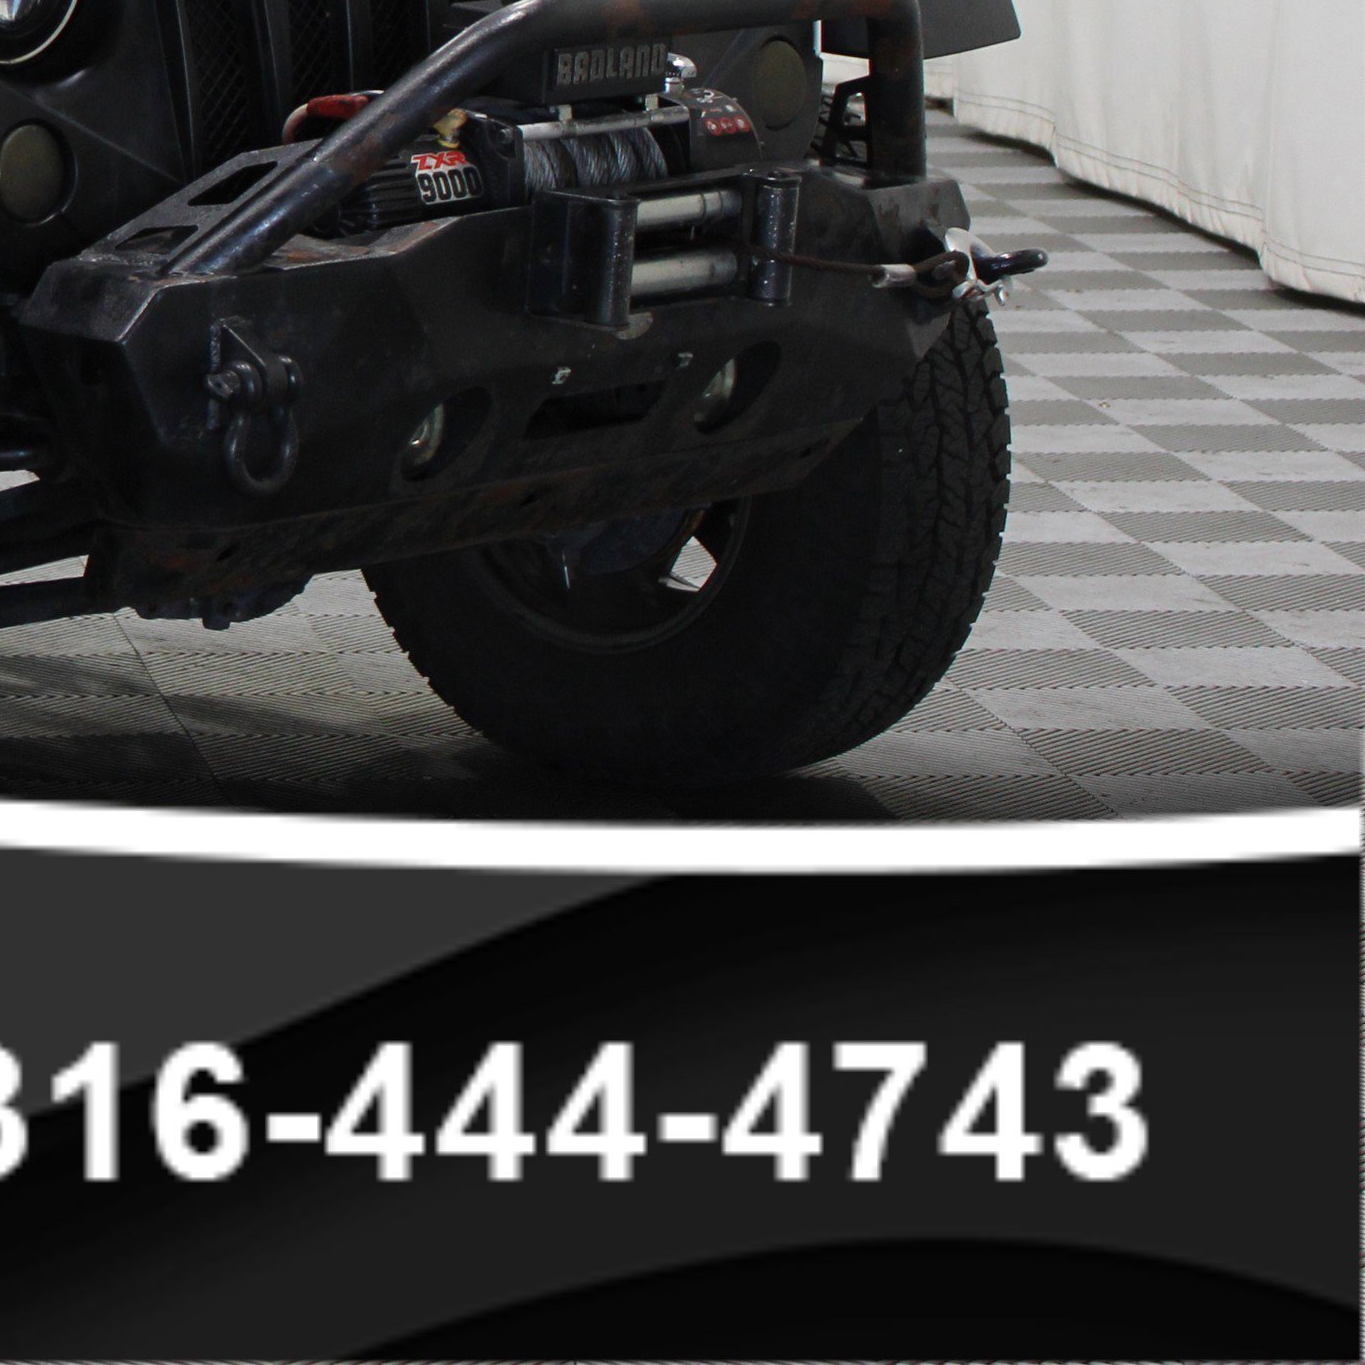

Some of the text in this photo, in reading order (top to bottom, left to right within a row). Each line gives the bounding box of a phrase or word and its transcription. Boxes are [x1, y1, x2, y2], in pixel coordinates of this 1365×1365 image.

[556, 43, 667, 86] BADLAND
[412, 150, 468, 171] ZXR
[417, 165, 482, 204] 9000
